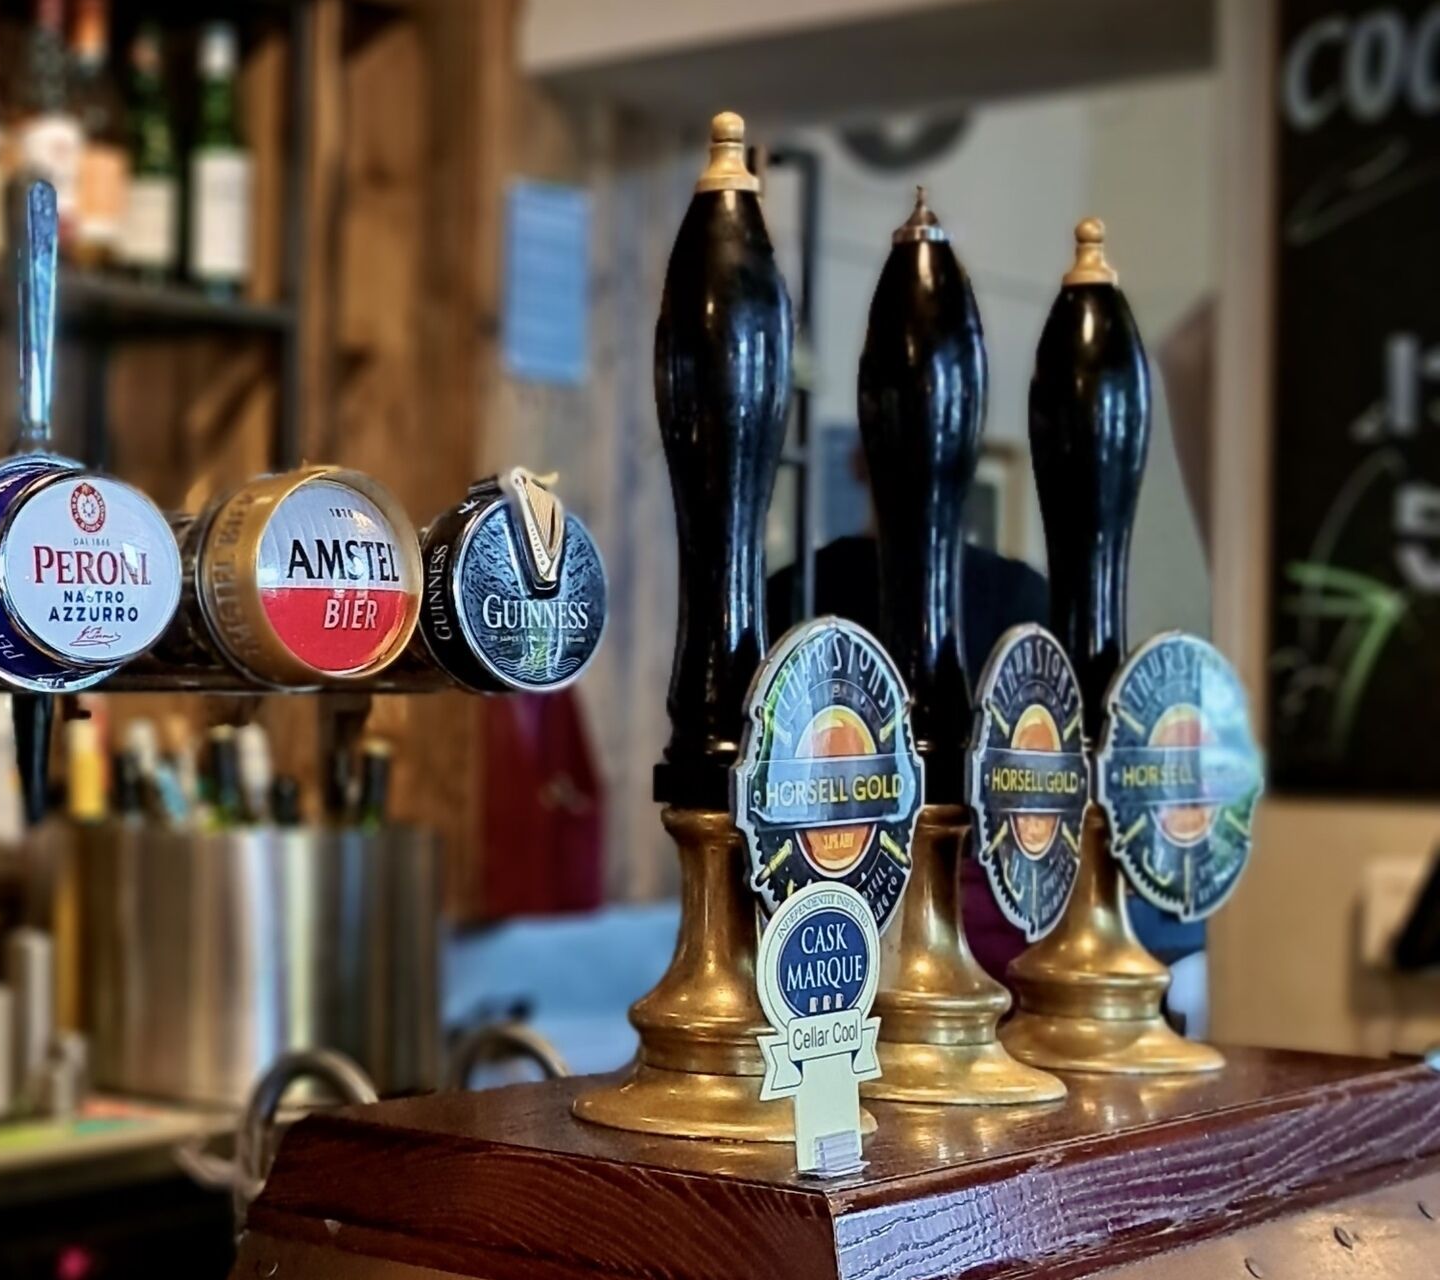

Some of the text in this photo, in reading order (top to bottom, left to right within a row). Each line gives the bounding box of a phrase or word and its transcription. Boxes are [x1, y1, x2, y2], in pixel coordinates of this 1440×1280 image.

[33, 545, 152, 586] PERONI
[286, 538, 400, 582] AMSTEL
[434, 542, 453, 642] GUINNESS
[48, 606, 139, 622] AZZURRO
[323, 599, 378, 629] BIER
[482, 593, 592, 630] GUINNESS
[765, 774, 905, 809] HORSELL GOLD
[991, 766, 1079, 794] HORSELL GOLD
[800, 922, 849, 955] CASK
[786, 954, 863, 992] MARQUE
[792, 1019, 859, 1052] Cellar Cool
